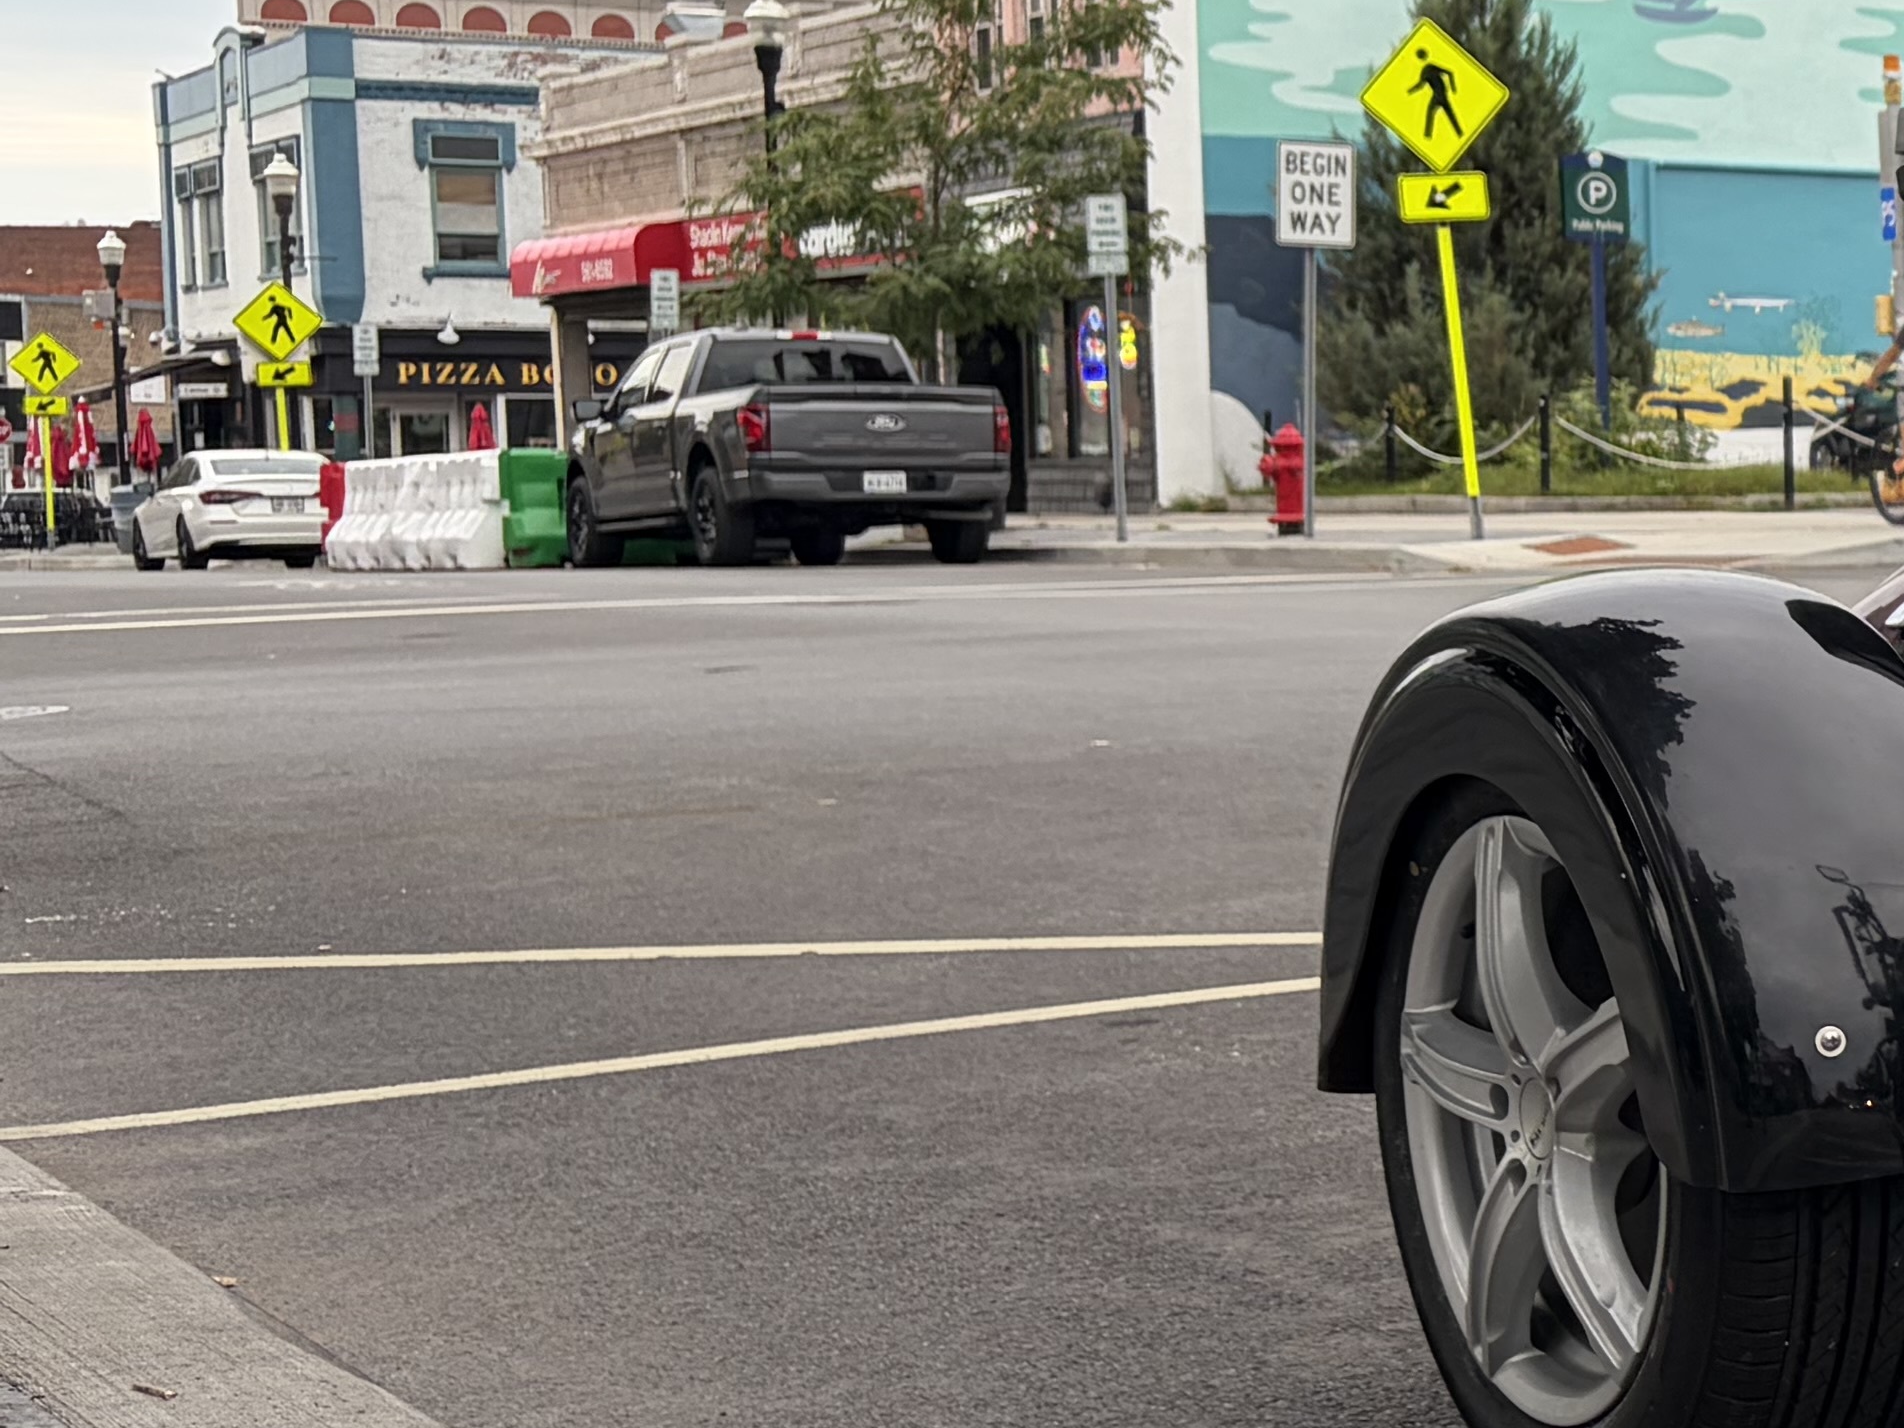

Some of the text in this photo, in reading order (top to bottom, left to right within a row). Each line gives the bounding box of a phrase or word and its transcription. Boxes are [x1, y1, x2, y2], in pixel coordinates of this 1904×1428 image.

[1285, 151, 1347, 178] BEGIN
[1291, 181, 1342, 207] ONE
[1589, 179, 1608, 205] P
[1290, 211, 1341, 236] WAY
[1572, 218, 1624, 234] Public Parking
[398, 362, 506, 386] PIZZA
